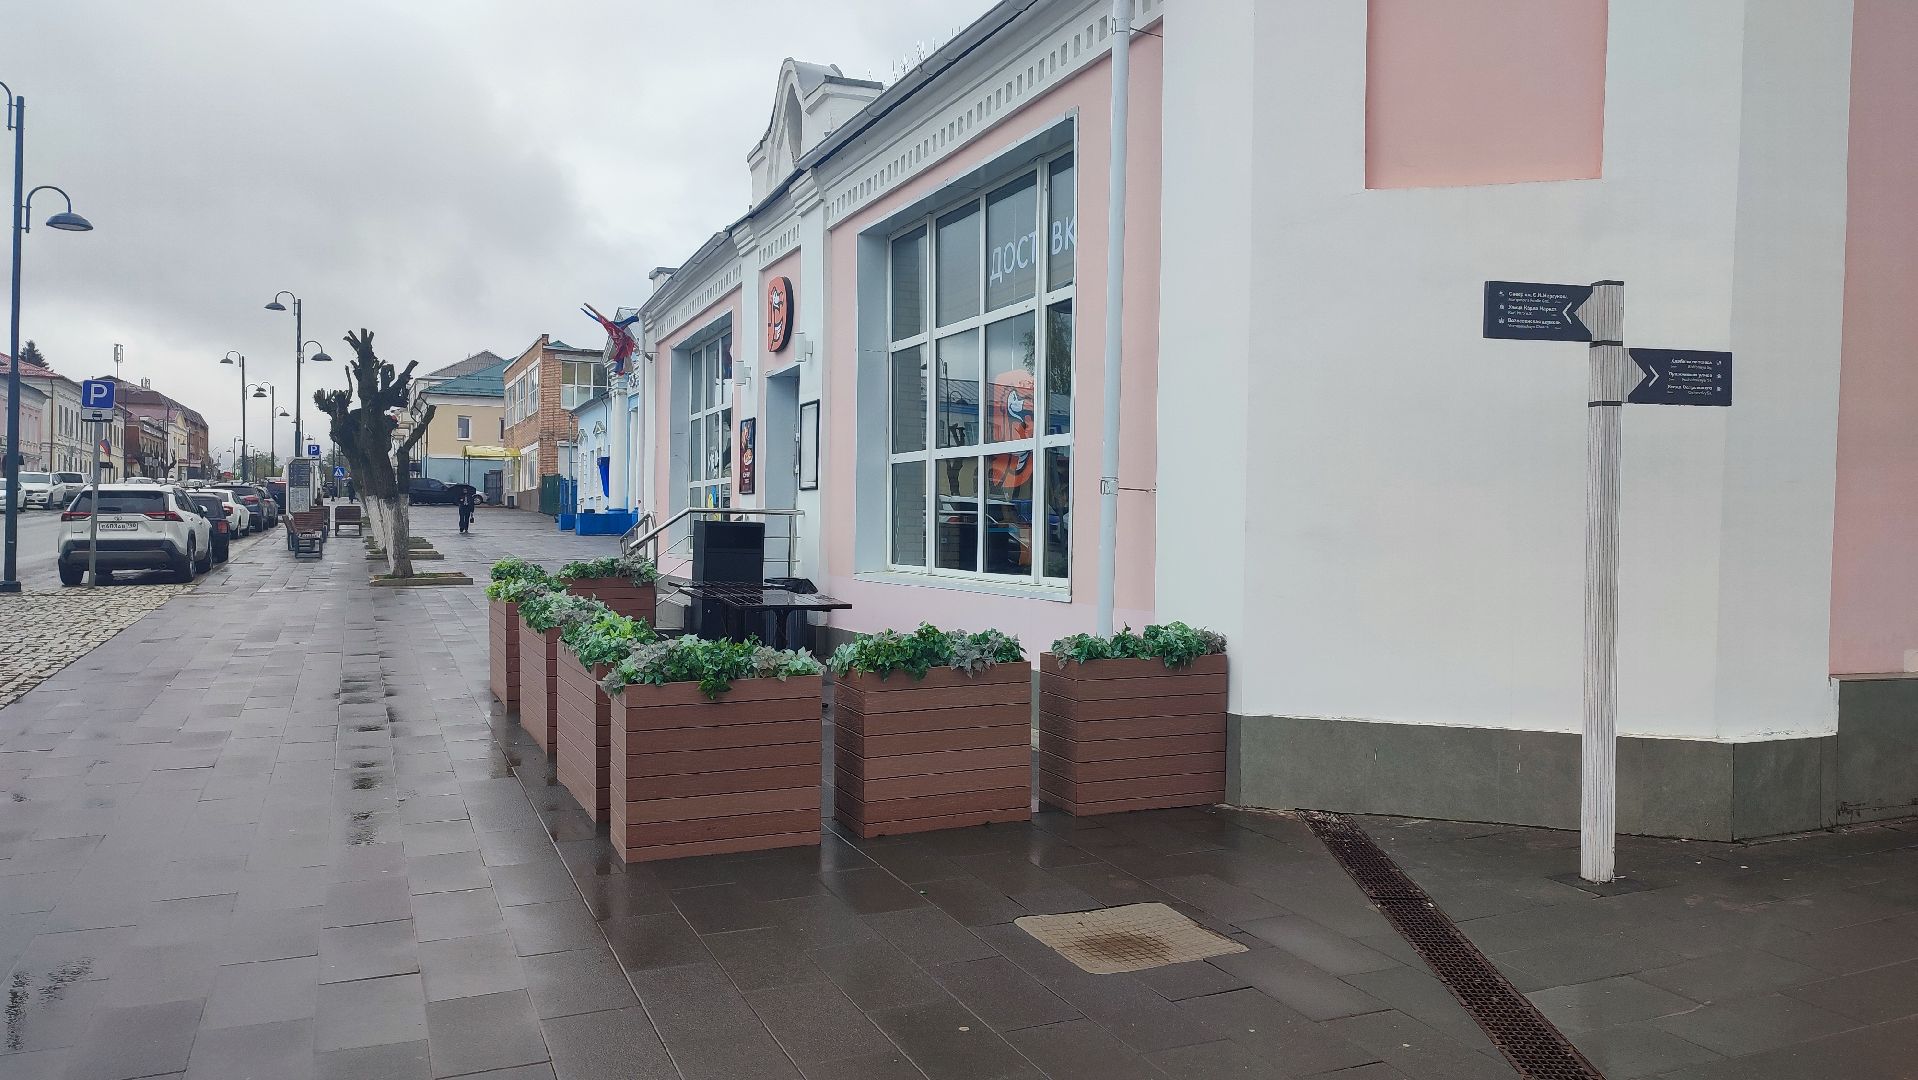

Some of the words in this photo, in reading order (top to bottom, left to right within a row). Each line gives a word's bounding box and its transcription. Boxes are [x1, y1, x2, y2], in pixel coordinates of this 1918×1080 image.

[990, 216, 1075, 287] ДОСТВК
[1523, 304, 1539, 312] Карла
[90, 384, 107, 404] P
[311, 445, 318, 454] P
